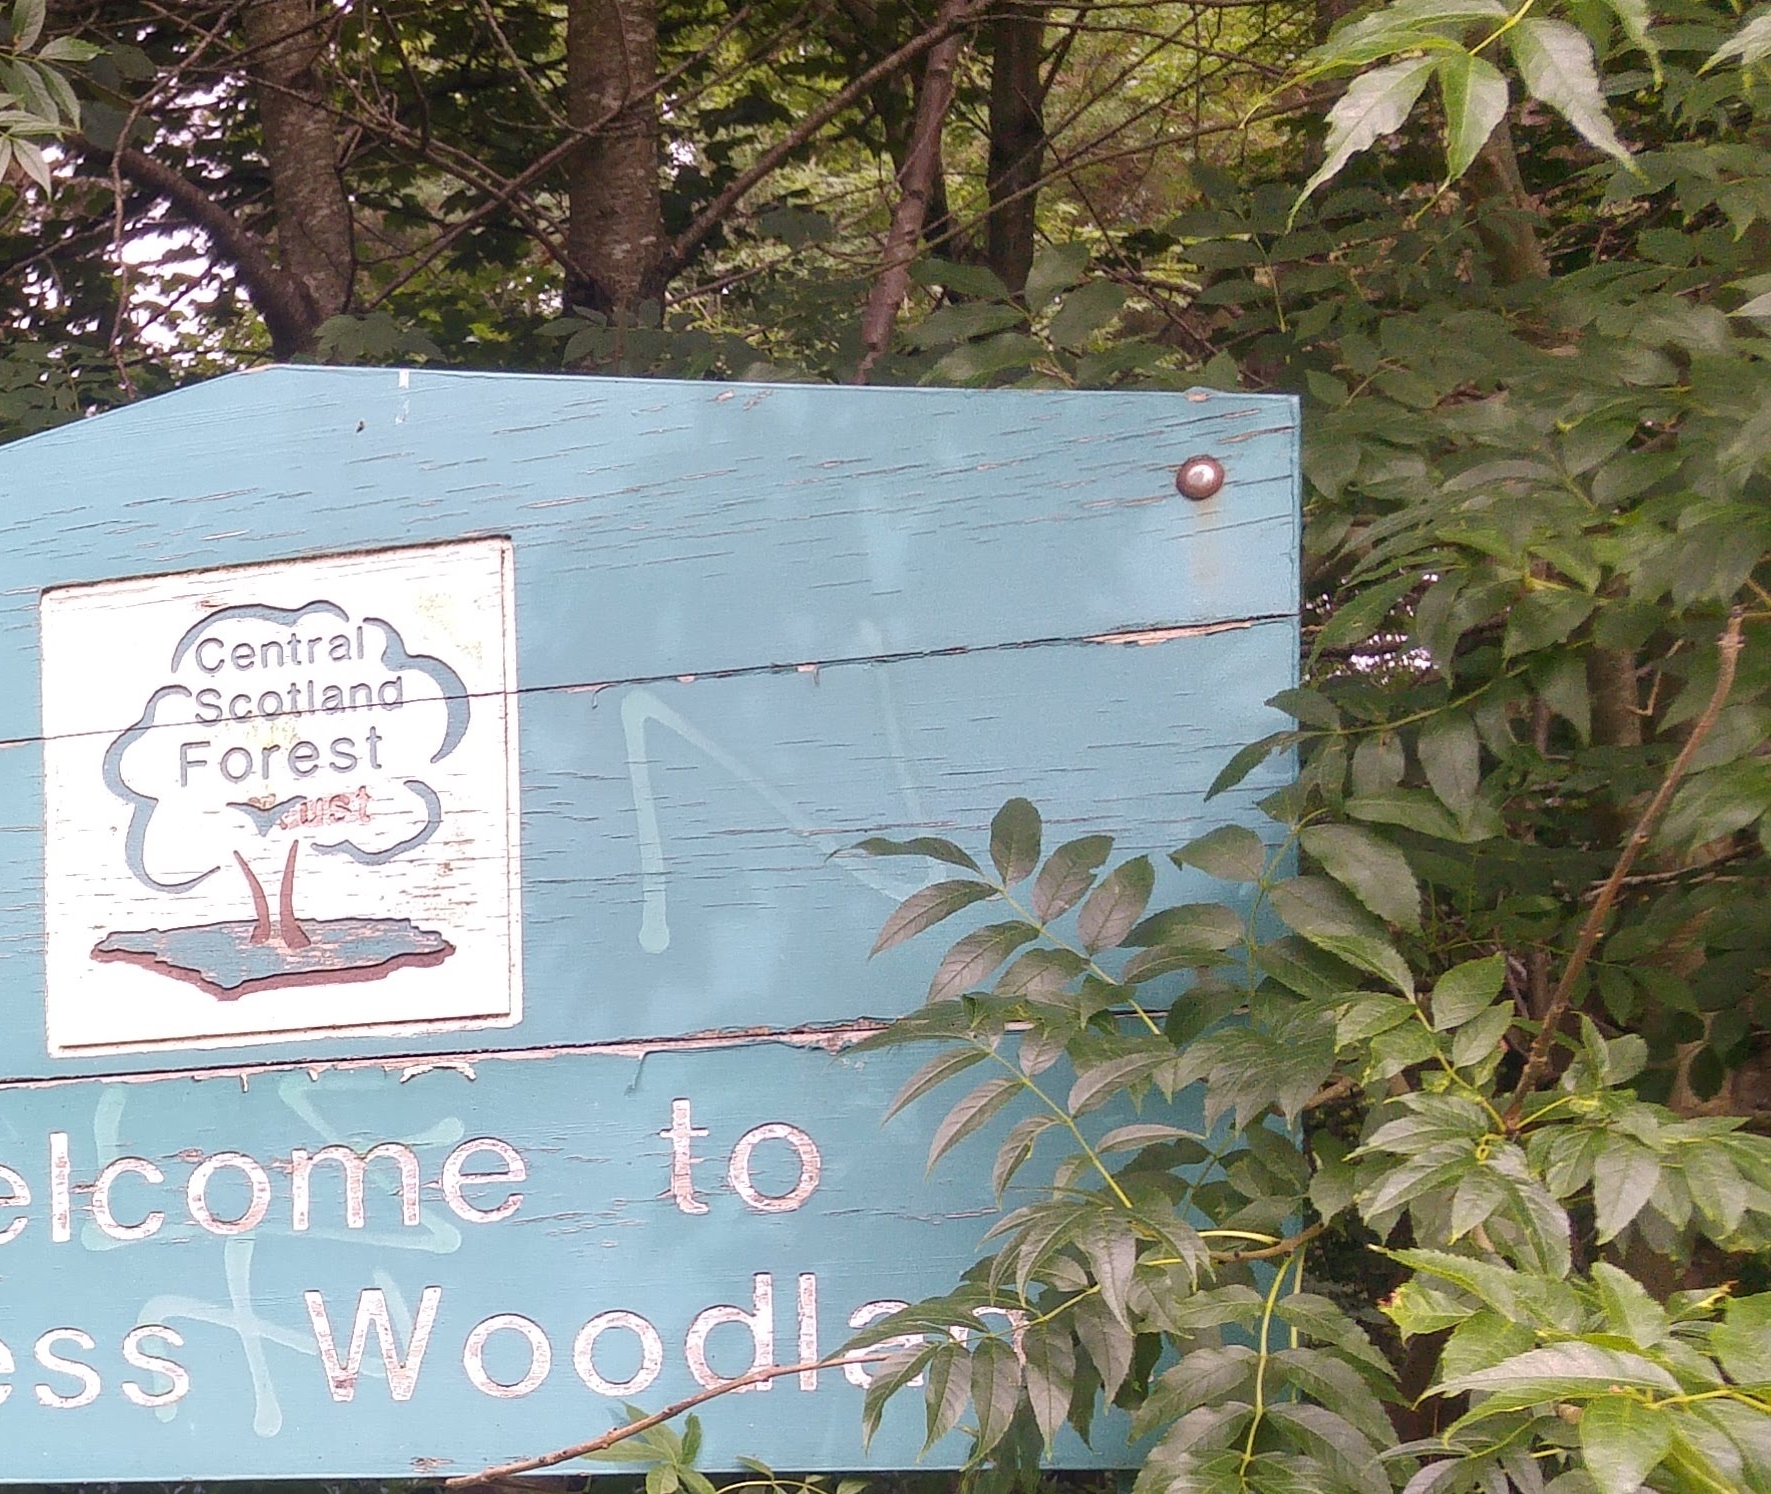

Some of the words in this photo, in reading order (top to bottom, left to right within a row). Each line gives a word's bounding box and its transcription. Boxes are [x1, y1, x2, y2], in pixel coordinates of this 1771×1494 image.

[195, 625, 365, 675] Central
[195, 676, 404, 725] Scotland
[179, 725, 383, 786] Forest
[659, 1097, 822, 1214] to
